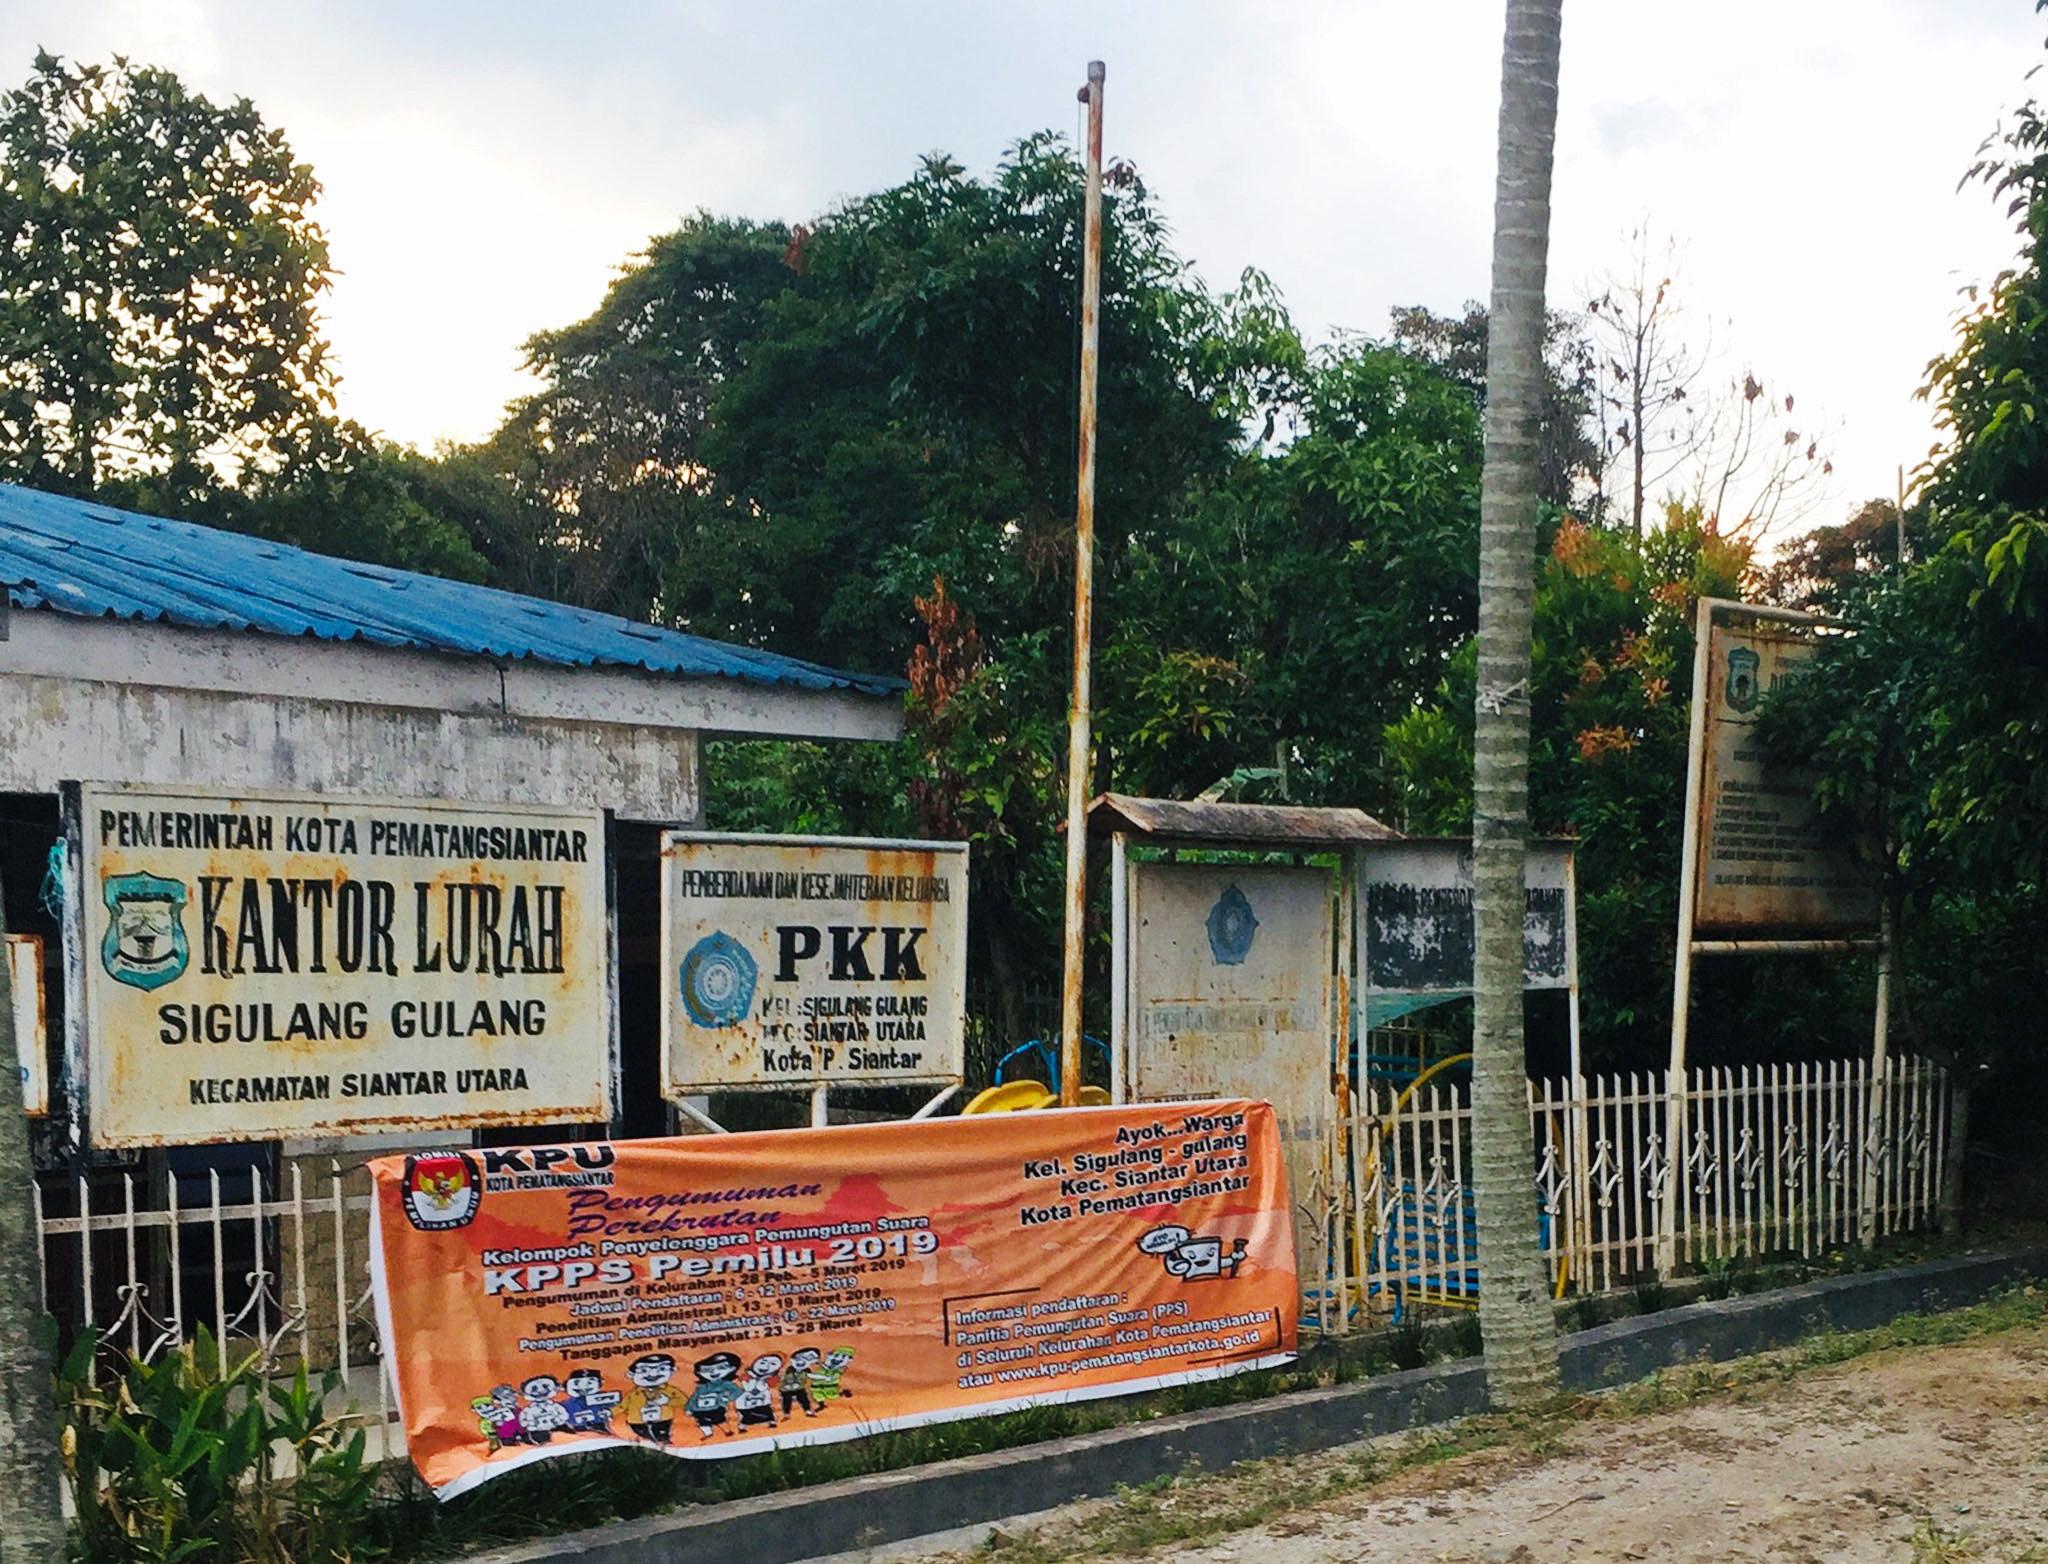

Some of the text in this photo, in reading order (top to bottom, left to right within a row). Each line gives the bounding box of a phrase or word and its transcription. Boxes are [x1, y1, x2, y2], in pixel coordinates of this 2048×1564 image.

[100, 810, 588, 863] PEMERINTAH KOTA PEMATANGSIANTAR
[775, 872, 799, 900] DAN
[197, 876, 567, 980] KANTOR LURAH
[773, 925, 928, 982] PKK
[159, 999, 547, 1045] SIGULANG GULANG
[876, 995, 929, 1018] GULANG
[876, 1021, 927, 1042] UTARA
[762, 1046, 813, 1072] Kota
[847, 1048, 923, 1070] Siantar
[189, 1067, 530, 1105] KECAMATAN SIANTAR UTARA
[483, 1146, 615, 1173] KPU
[1024, 1158, 1068, 1180] Kel.
[1073, 1147, 1164, 1173] Sigulang
[1182, 1133, 1249, 1160] gulang
[1060, 1154, 1249, 1197] Kec. Siantar Utara
[484, 1171, 615, 1192] KOTA PEMATANGSIANTAR
[566, 1183, 822, 1216] Pengumuman
[1020, 1174, 1250, 1226] Kota Pematangsiantar
[482, 1215, 930, 1267] Kelompok Penyelenggara Pemungutan Suara
[566, 1209, 782, 1242] Perekrutan
[483, 1230, 941, 1296] KPPS Pemilu 2019
[502, 1288, 620, 1309] Pengumuman
[623, 1284, 642, 1297] di
[646, 1278, 727, 1296] Kelurahan
[823, 1263, 868, 1278] Maret
[869, 1258, 906, 1272] 2019
[535, 1314, 622, 1335] Penelitian
[626, 1304, 728, 1325] Administrasi
[742, 1300, 762, 1313] 13
[798, 1292, 842, 1306] Maret
[845, 1287, 882, 1301] 2019
[569, 1300, 628, 1317] Jadwal
[632, 1290, 723, 1309] Pendaftaran
[734, 1288, 745, 1300] 6
[757, 1285, 776, 1298] 12
[779, 1280, 820, 1297] Maret
[823, 1276, 858, 1291] 2019
[956, 1302, 1029, 1326] Informasi
[1032, 1291, 1120, 1318] pendaftaran
[517, 1330, 616, 1352] Pengumuman
[619, 1322, 689, 1341] Penelitian
[691, 1313, 774, 1333] Administrasi
[828, 1303, 864, 1317] Maret
[866, 1298, 897, 1313] 2019
[560, 1341, 654, 1362] Tanggapan
[657, 1331, 750, 1352] Masyarakat
[819, 1318, 863, 1332] Maret
[956, 1301, 1190, 1346] Panitia Pemungutan Suara (PPS)
[957, 1309, 1271, 1369] di Seluruh Kelurahan Kota Pematangsiantar
[957, 1330, 1261, 1390] atau www.kpu-pematangsiantarkota.go.id
